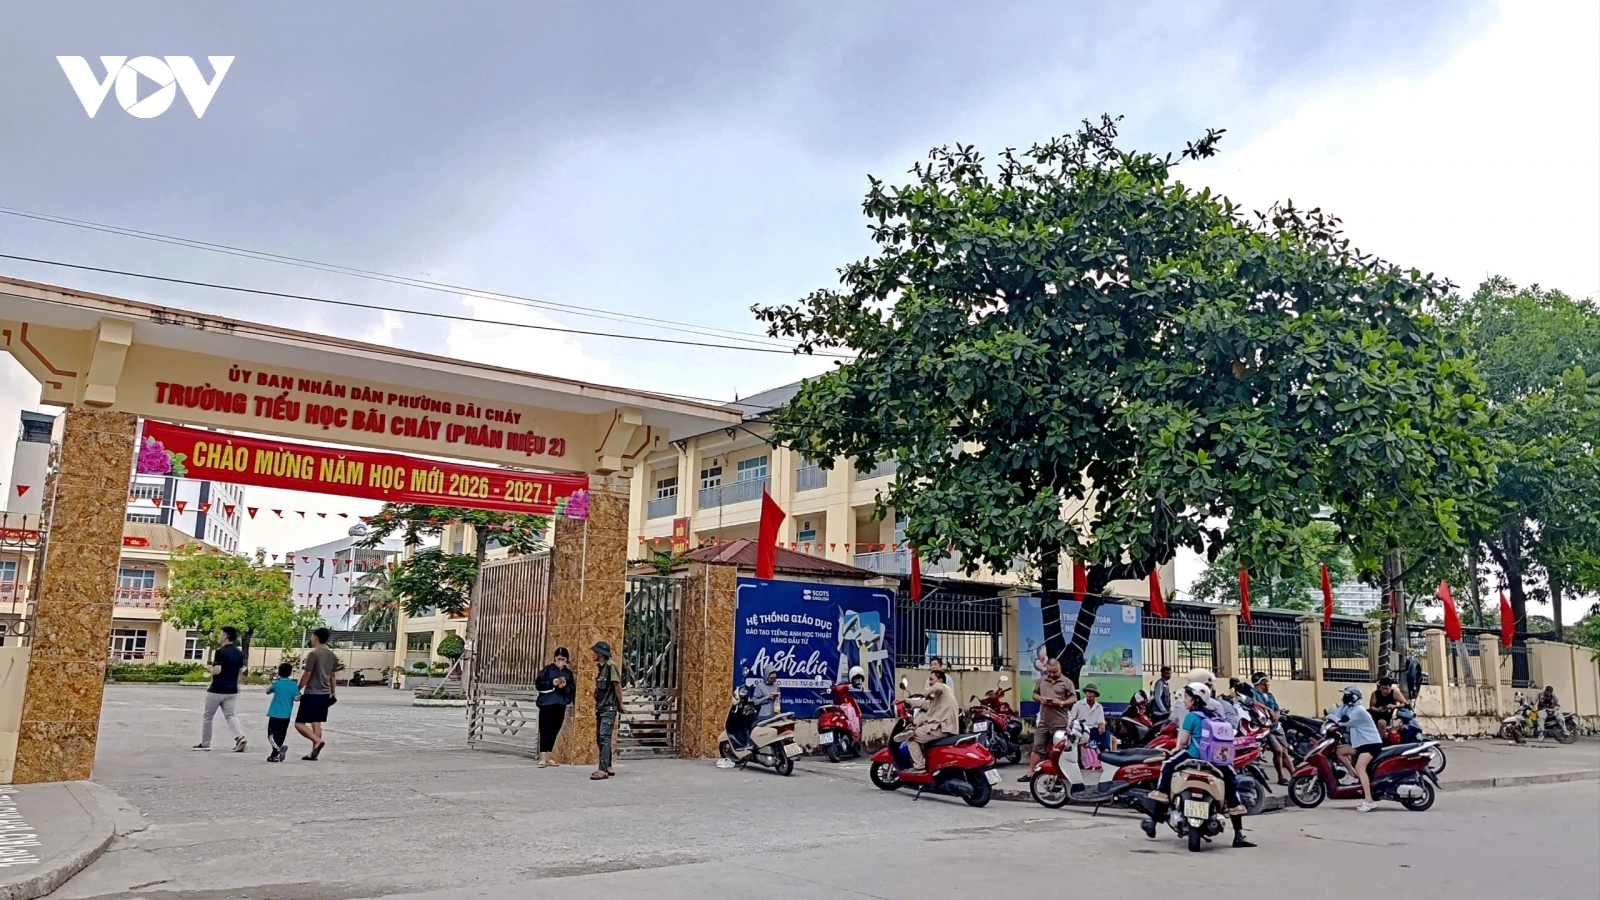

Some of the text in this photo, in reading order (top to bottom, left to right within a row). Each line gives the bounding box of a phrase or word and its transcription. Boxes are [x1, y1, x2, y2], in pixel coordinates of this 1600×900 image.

[228, 364, 522, 425] ỦY BAN NHÂN DÂN PHƯỜNG BÃI CHÁY
[156, 381, 566, 458] TRƯỜNG TIỂU HỌC BÃI CHÁY (PHÂN HIỆU 2)
[192, 440, 249, 472] CHÀO
[254, 446, 314, 480] MỪNG
[319, 454, 364, 486] NĂM
[369, 463, 406, 494] HỌC
[410, 466, 445, 493] MỚI
[449, 473, 489, 499] 2026
[504, 479, 543, 504] 2027
[746, 611, 832, 630] HỆ THỐNG GIÁO DỤC
[759, 629, 770, 637] TẠO
[771, 628, 788, 636] TIẾNG
[1099, 627, 1111, 635] HAY
